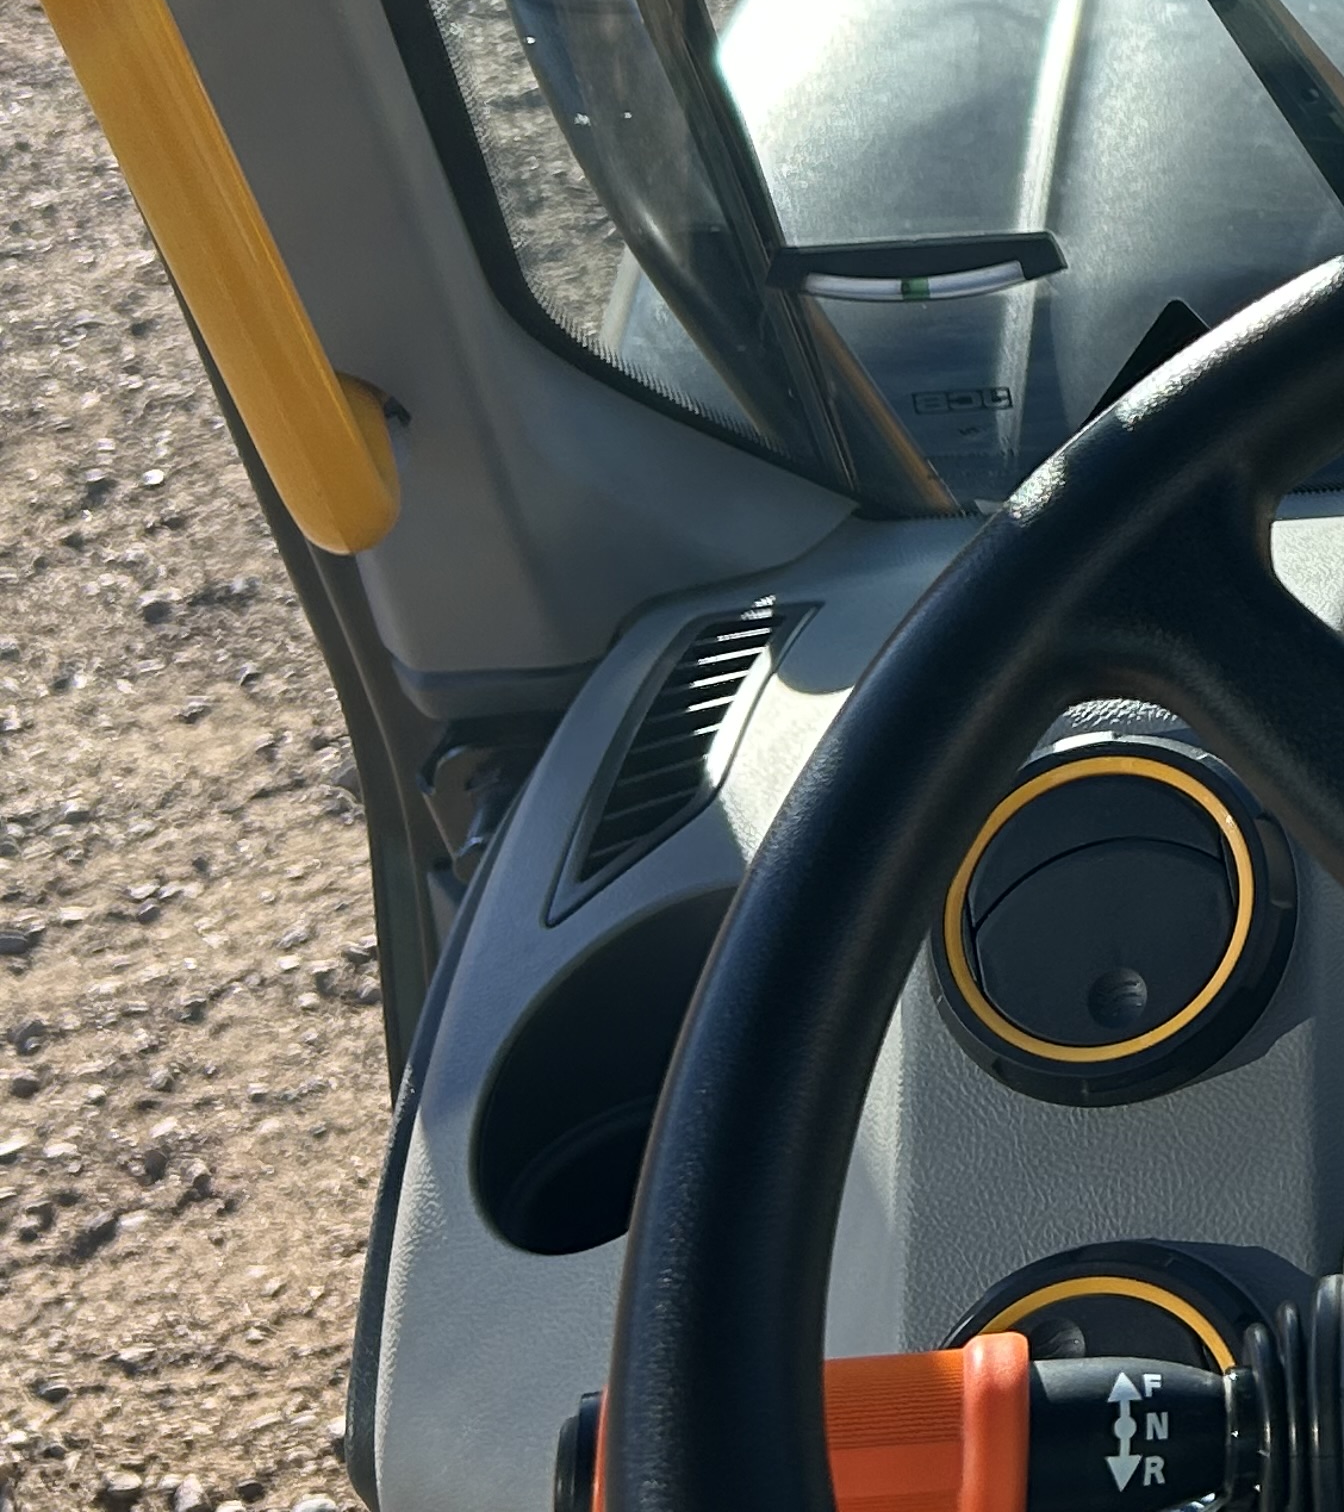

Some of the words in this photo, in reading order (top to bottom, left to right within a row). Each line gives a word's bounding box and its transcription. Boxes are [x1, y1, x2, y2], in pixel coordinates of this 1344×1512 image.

[1142, 1373, 1162, 1397] F
[1145, 1411, 1168, 1441] N
[1143, 1456, 1166, 1487] R
